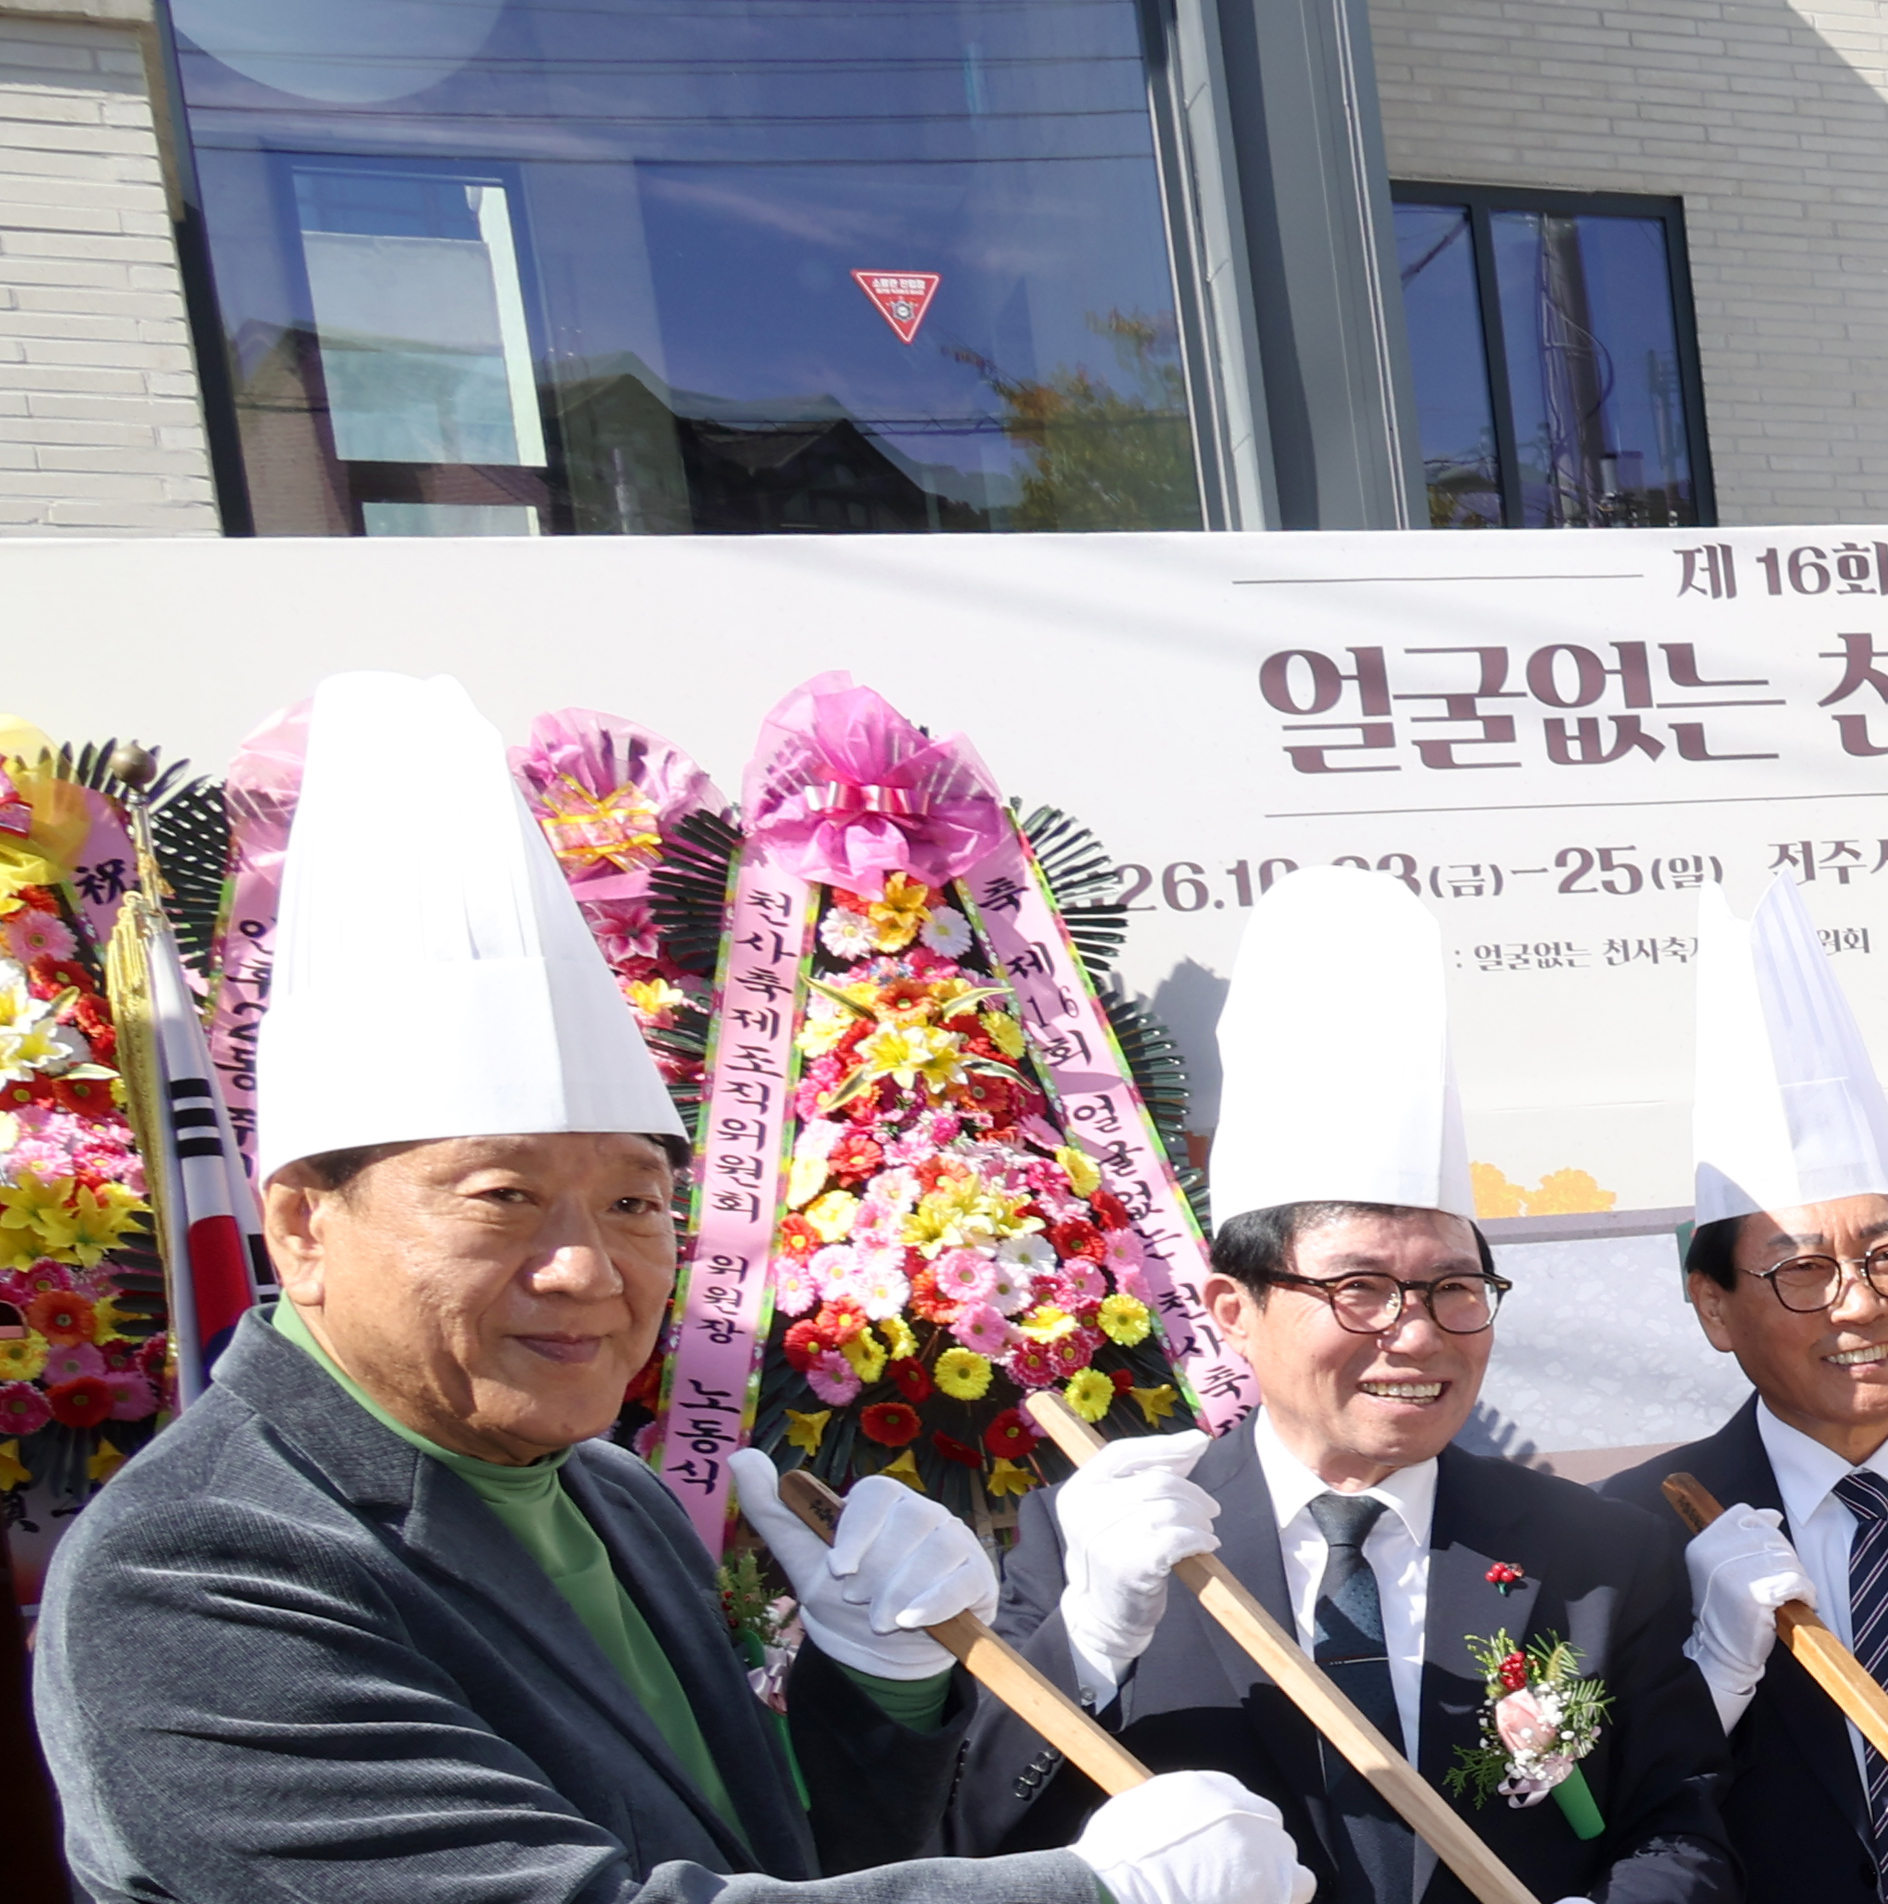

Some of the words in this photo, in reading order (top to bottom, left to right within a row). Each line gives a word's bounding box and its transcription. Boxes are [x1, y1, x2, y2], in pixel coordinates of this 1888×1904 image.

[1675, 544, 1739, 599] 제
[1257, 638, 1787, 775] 얼굴없는
[1474, 941, 1592, 972] 얼굴없는
[1601, 936, 1699, 967] 천사축
[714, 888, 795, 1224] 천사축제조직위원회
[1072, 1094, 1182, 1261] 얼굴없는
[696, 1253, 749, 1345] 위원장
[667, 1378, 740, 1496] 노동식
